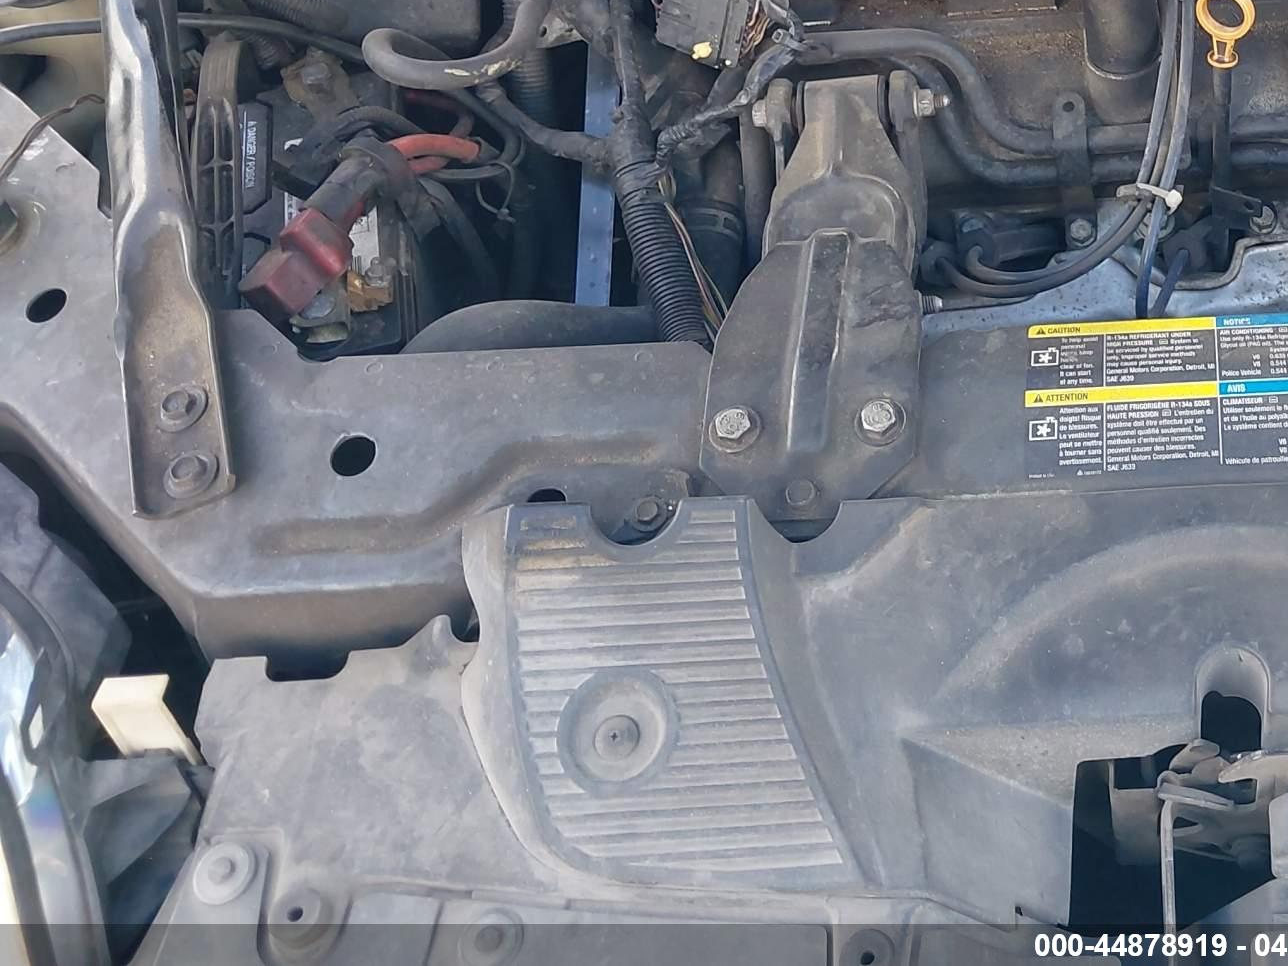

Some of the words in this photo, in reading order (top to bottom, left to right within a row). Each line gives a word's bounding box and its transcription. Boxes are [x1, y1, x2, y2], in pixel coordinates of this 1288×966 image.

[246, 127, 257, 155] DANGER
[245, 161, 256, 188] POISON
[1227, 384, 1246, 393] AVIS
[1046, 393, 1088, 402] ATTENTION
[1222, 397, 1263, 405] CLIMATISEUR
[1107, 412, 1127, 420] HAUTE
[1128, 411, 1159, 419] PRESSION
